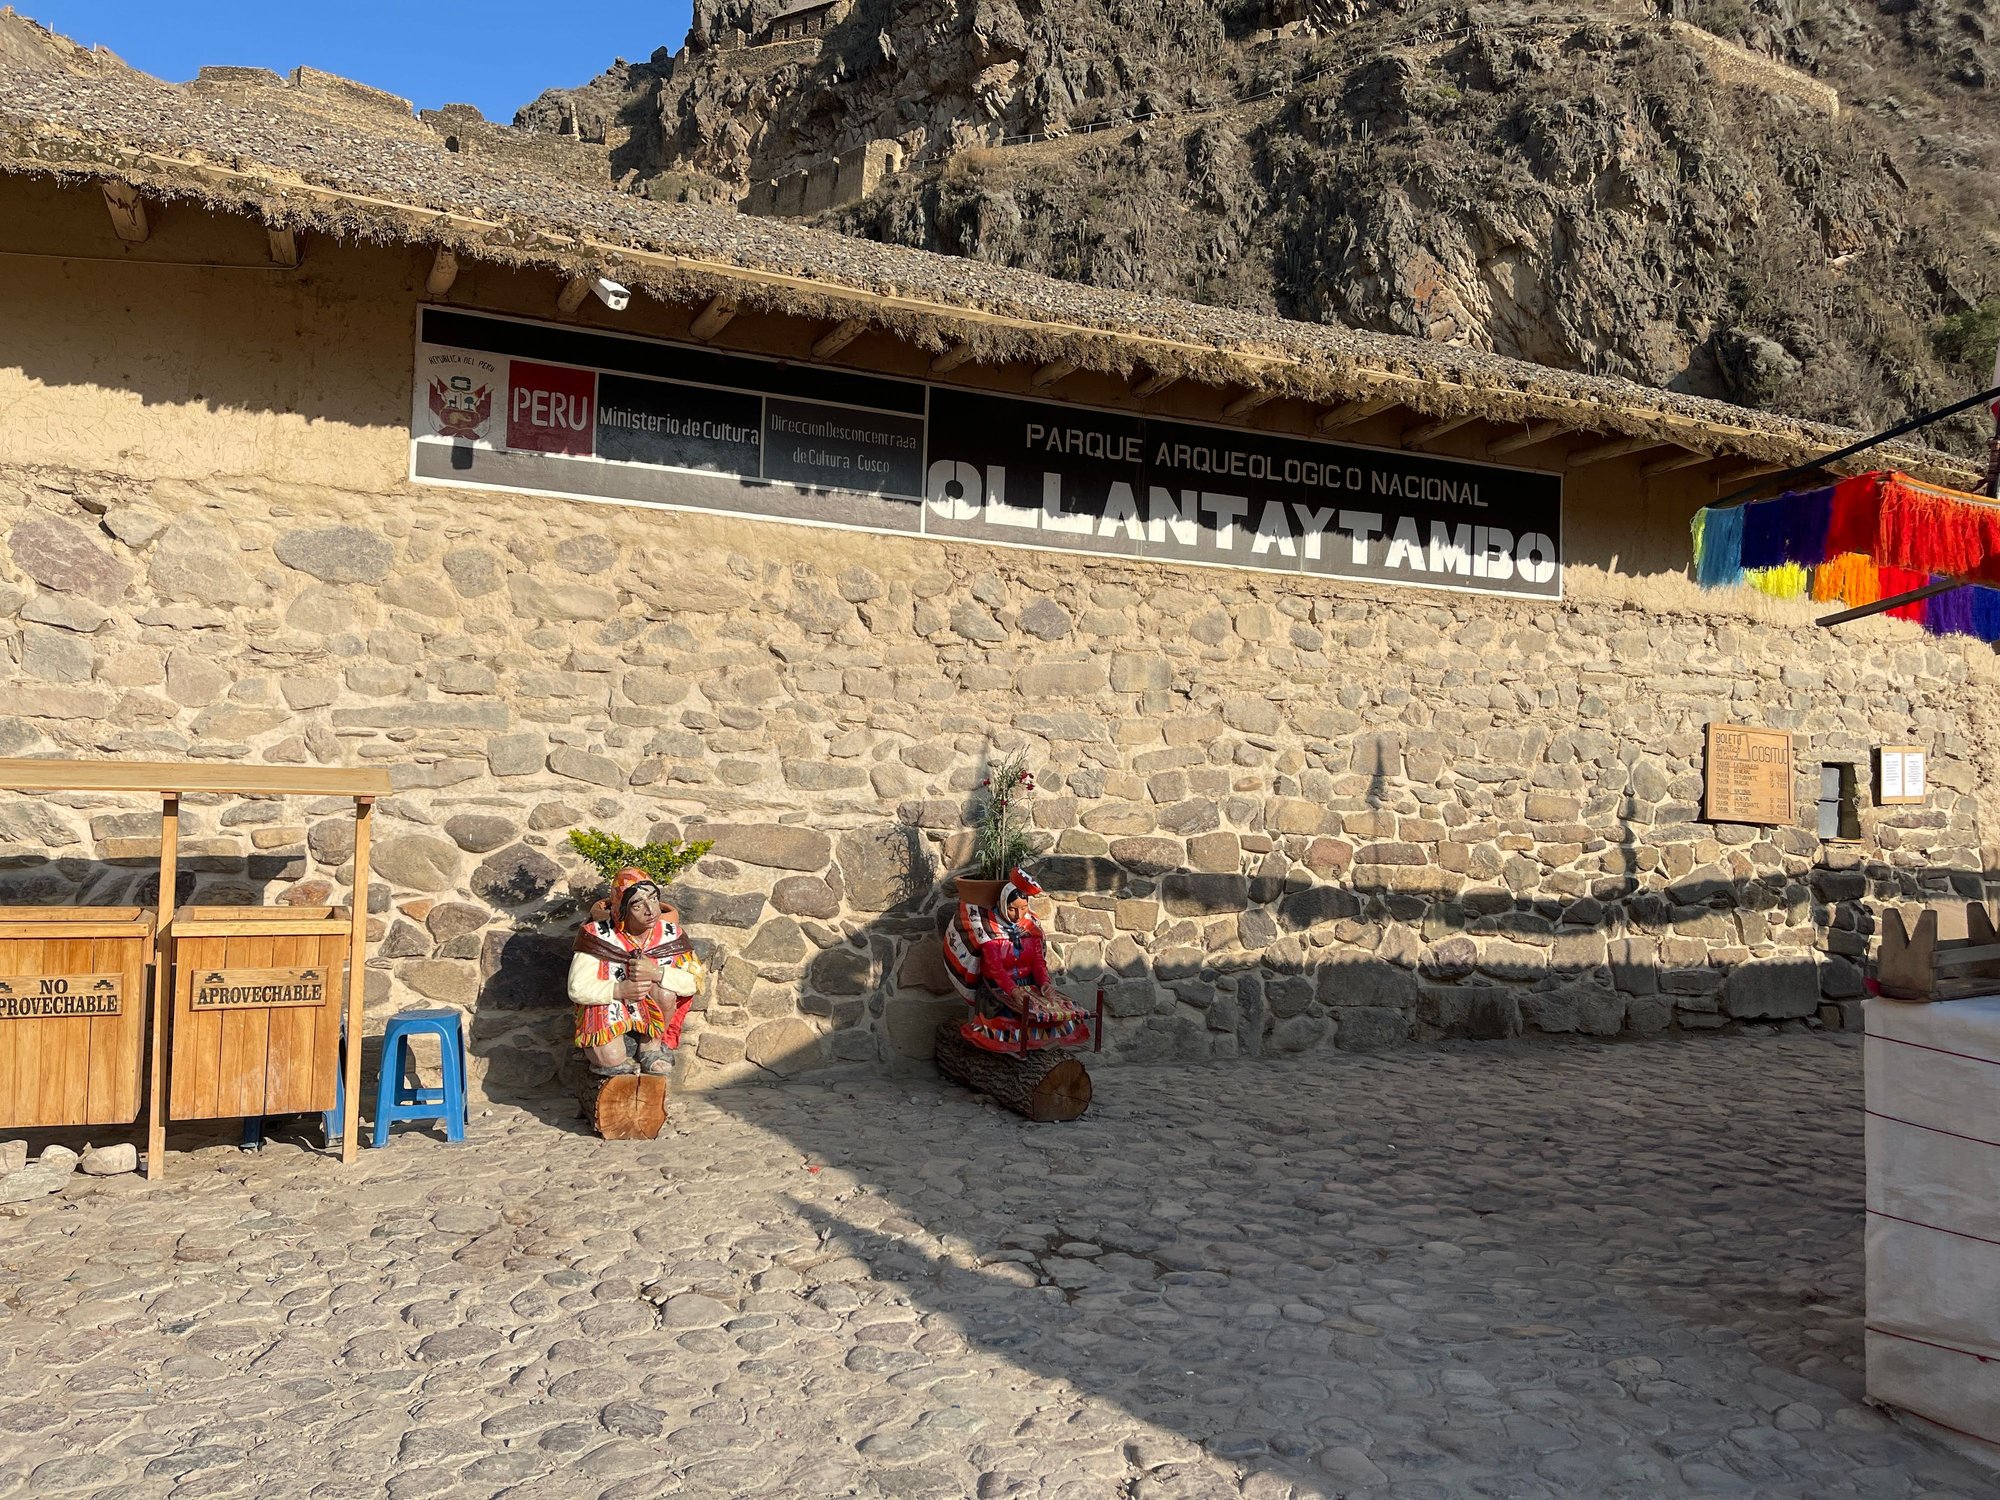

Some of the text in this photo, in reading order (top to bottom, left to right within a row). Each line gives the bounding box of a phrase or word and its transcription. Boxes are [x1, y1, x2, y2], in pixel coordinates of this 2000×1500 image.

[428, 354, 496, 373] REPUBLICA DEL PERU
[513, 387, 588, 431] PERU
[600, 406, 680, 434] Ministerio
[702, 420, 760, 445] Cultura
[808, 449, 850, 469] Cultura
[858, 454, 890, 473] Cusco
[1026, 423, 1489, 507] PARQUE ARQUEOLOGICO NACIONAL
[927, 459, 1556, 584] OLLANTAYTAMBO
[1716, 733, 1742, 745] BOLETO
[39, 979, 68, 994] NO
[197, 984, 322, 1005] APROVECHABLE
[0, 994, 117, 1016] PROVECHABLE
